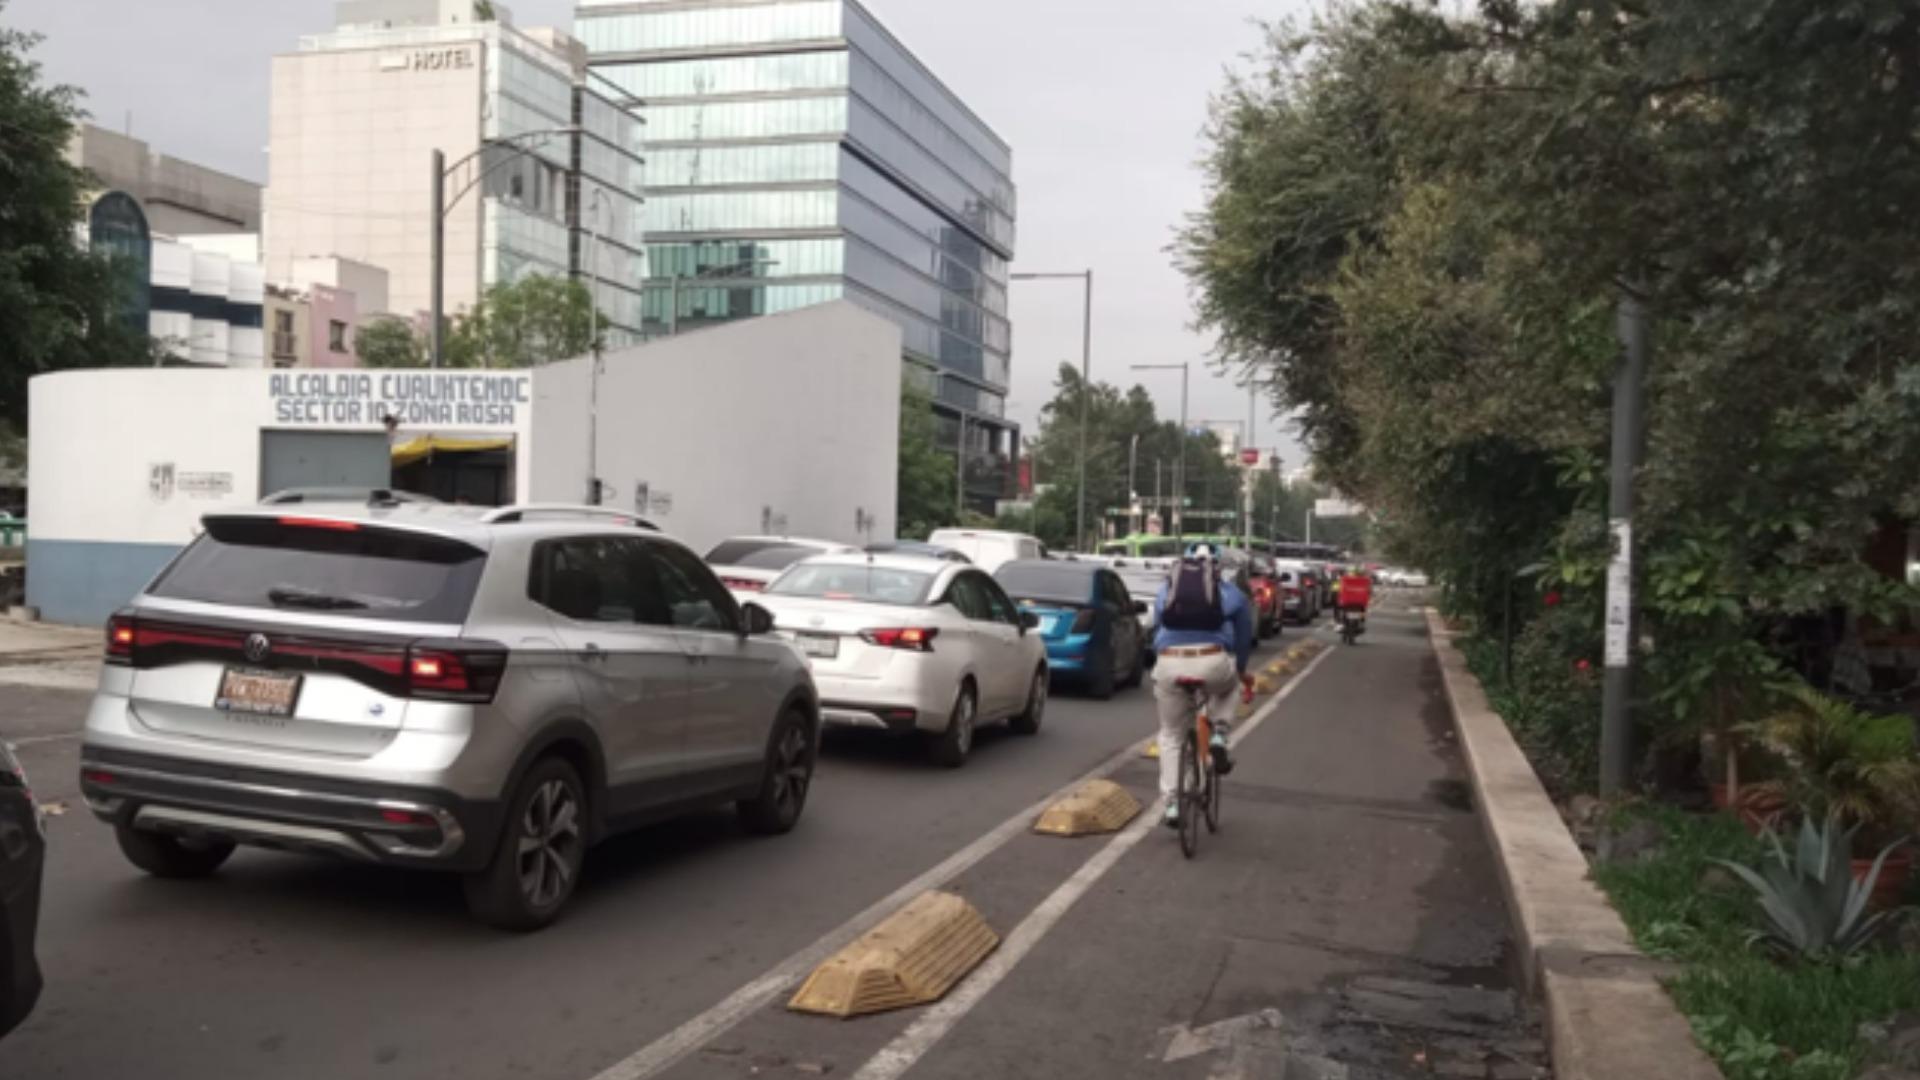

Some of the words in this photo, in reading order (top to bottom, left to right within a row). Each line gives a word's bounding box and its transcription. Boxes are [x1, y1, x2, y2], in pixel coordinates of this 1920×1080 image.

[414, 48, 474, 71] HOTEL
[277, 399, 361, 423] SECTOR
[367, 401, 389, 423] 10
[393, 401, 450, 424] ZONA
[457, 404, 516, 424] ROSA
